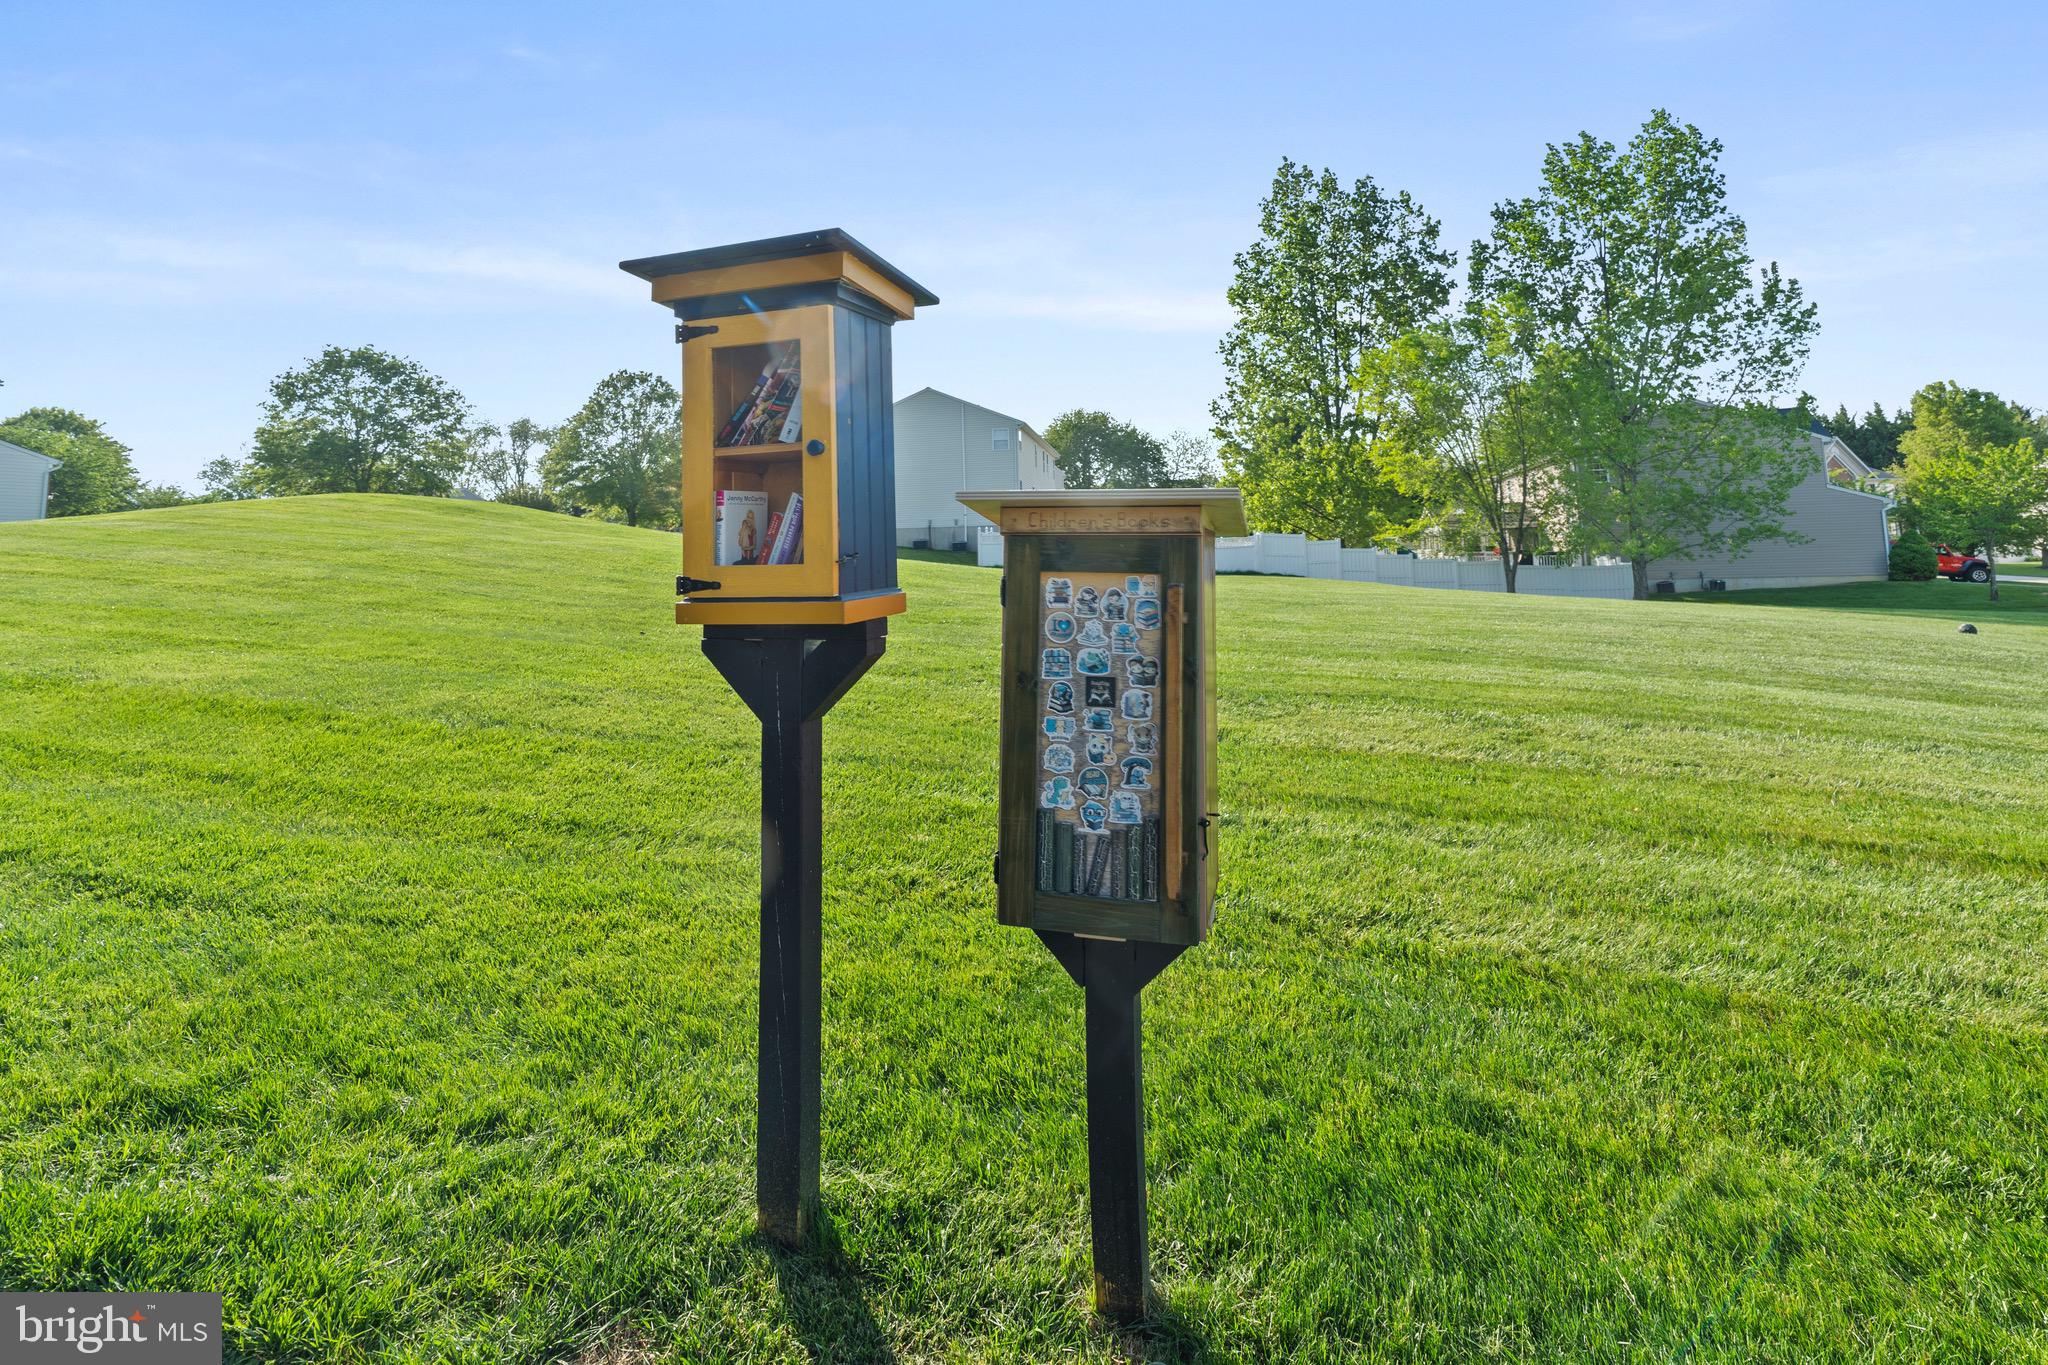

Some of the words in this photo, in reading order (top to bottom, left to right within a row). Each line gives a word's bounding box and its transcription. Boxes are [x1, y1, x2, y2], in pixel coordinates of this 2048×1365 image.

[727, 496, 743, 505] Jenny
[744, 496, 766, 504] McCarthy
[1028, 511, 1113, 529] Children's
[1117, 511, 1170, 528] Books
